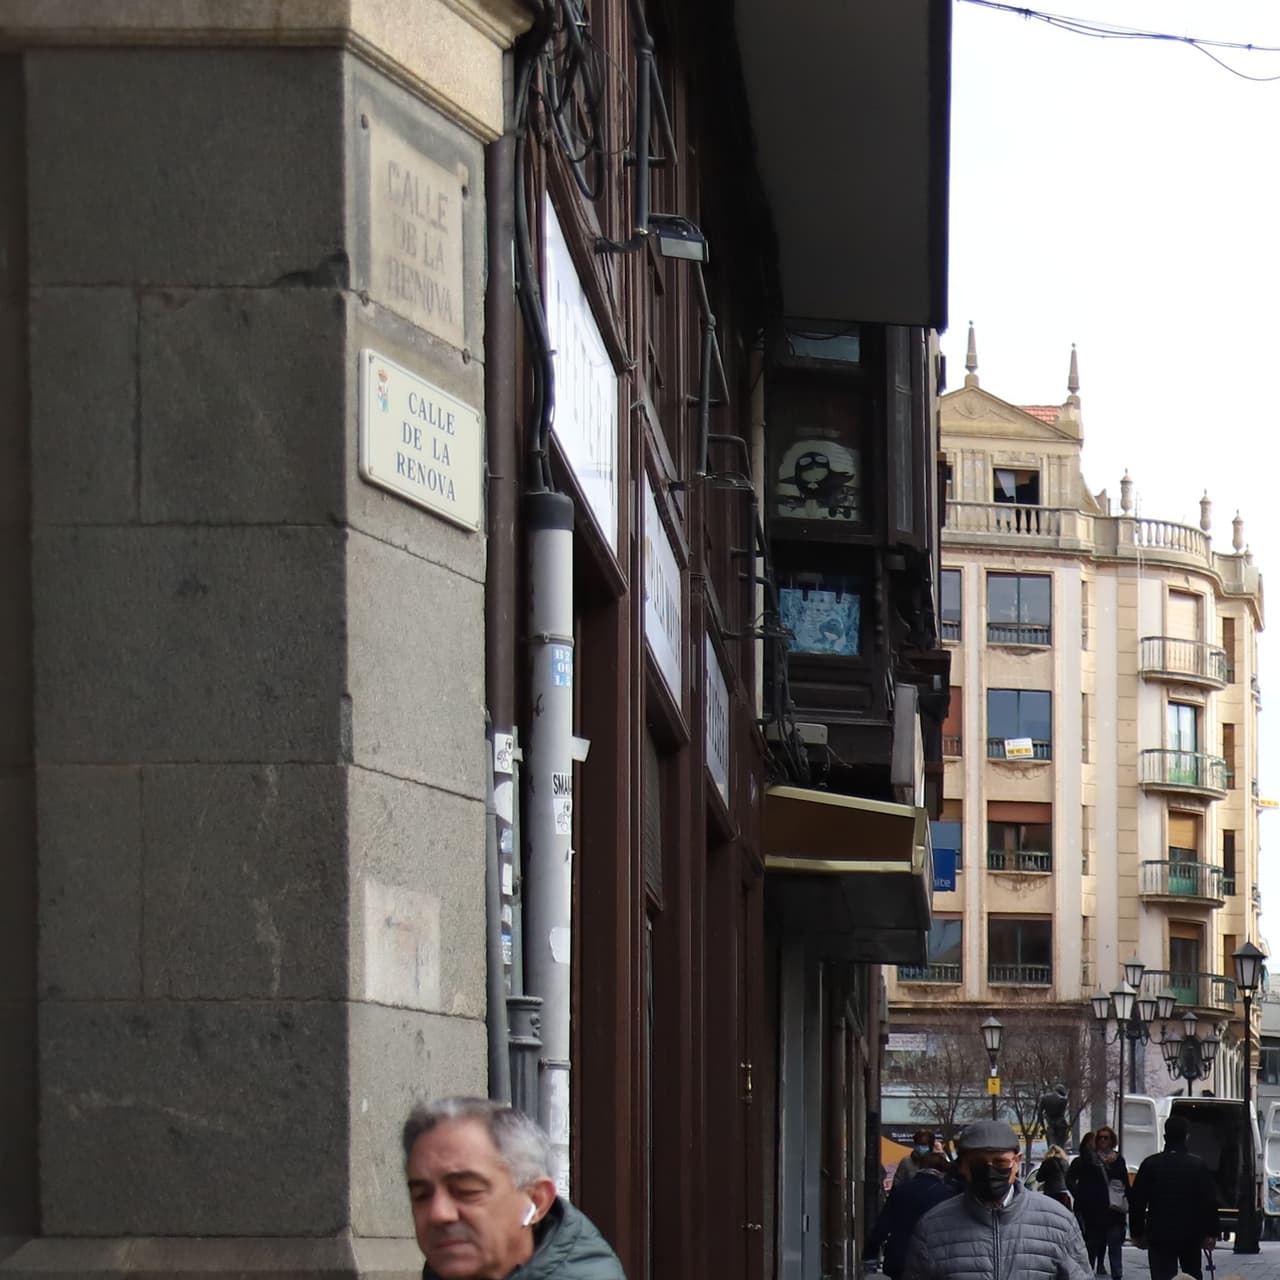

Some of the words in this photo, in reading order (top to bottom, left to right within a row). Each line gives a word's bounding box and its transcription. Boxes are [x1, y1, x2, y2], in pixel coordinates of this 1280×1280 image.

[388, 160, 449, 236] CALLE
[386, 256, 453, 323] RENOVA
[408, 391, 456, 436] CALLE
[402, 421, 423, 451] DE
[432, 437, 451, 467] LA
[396, 451, 456, 502] RENOVA
